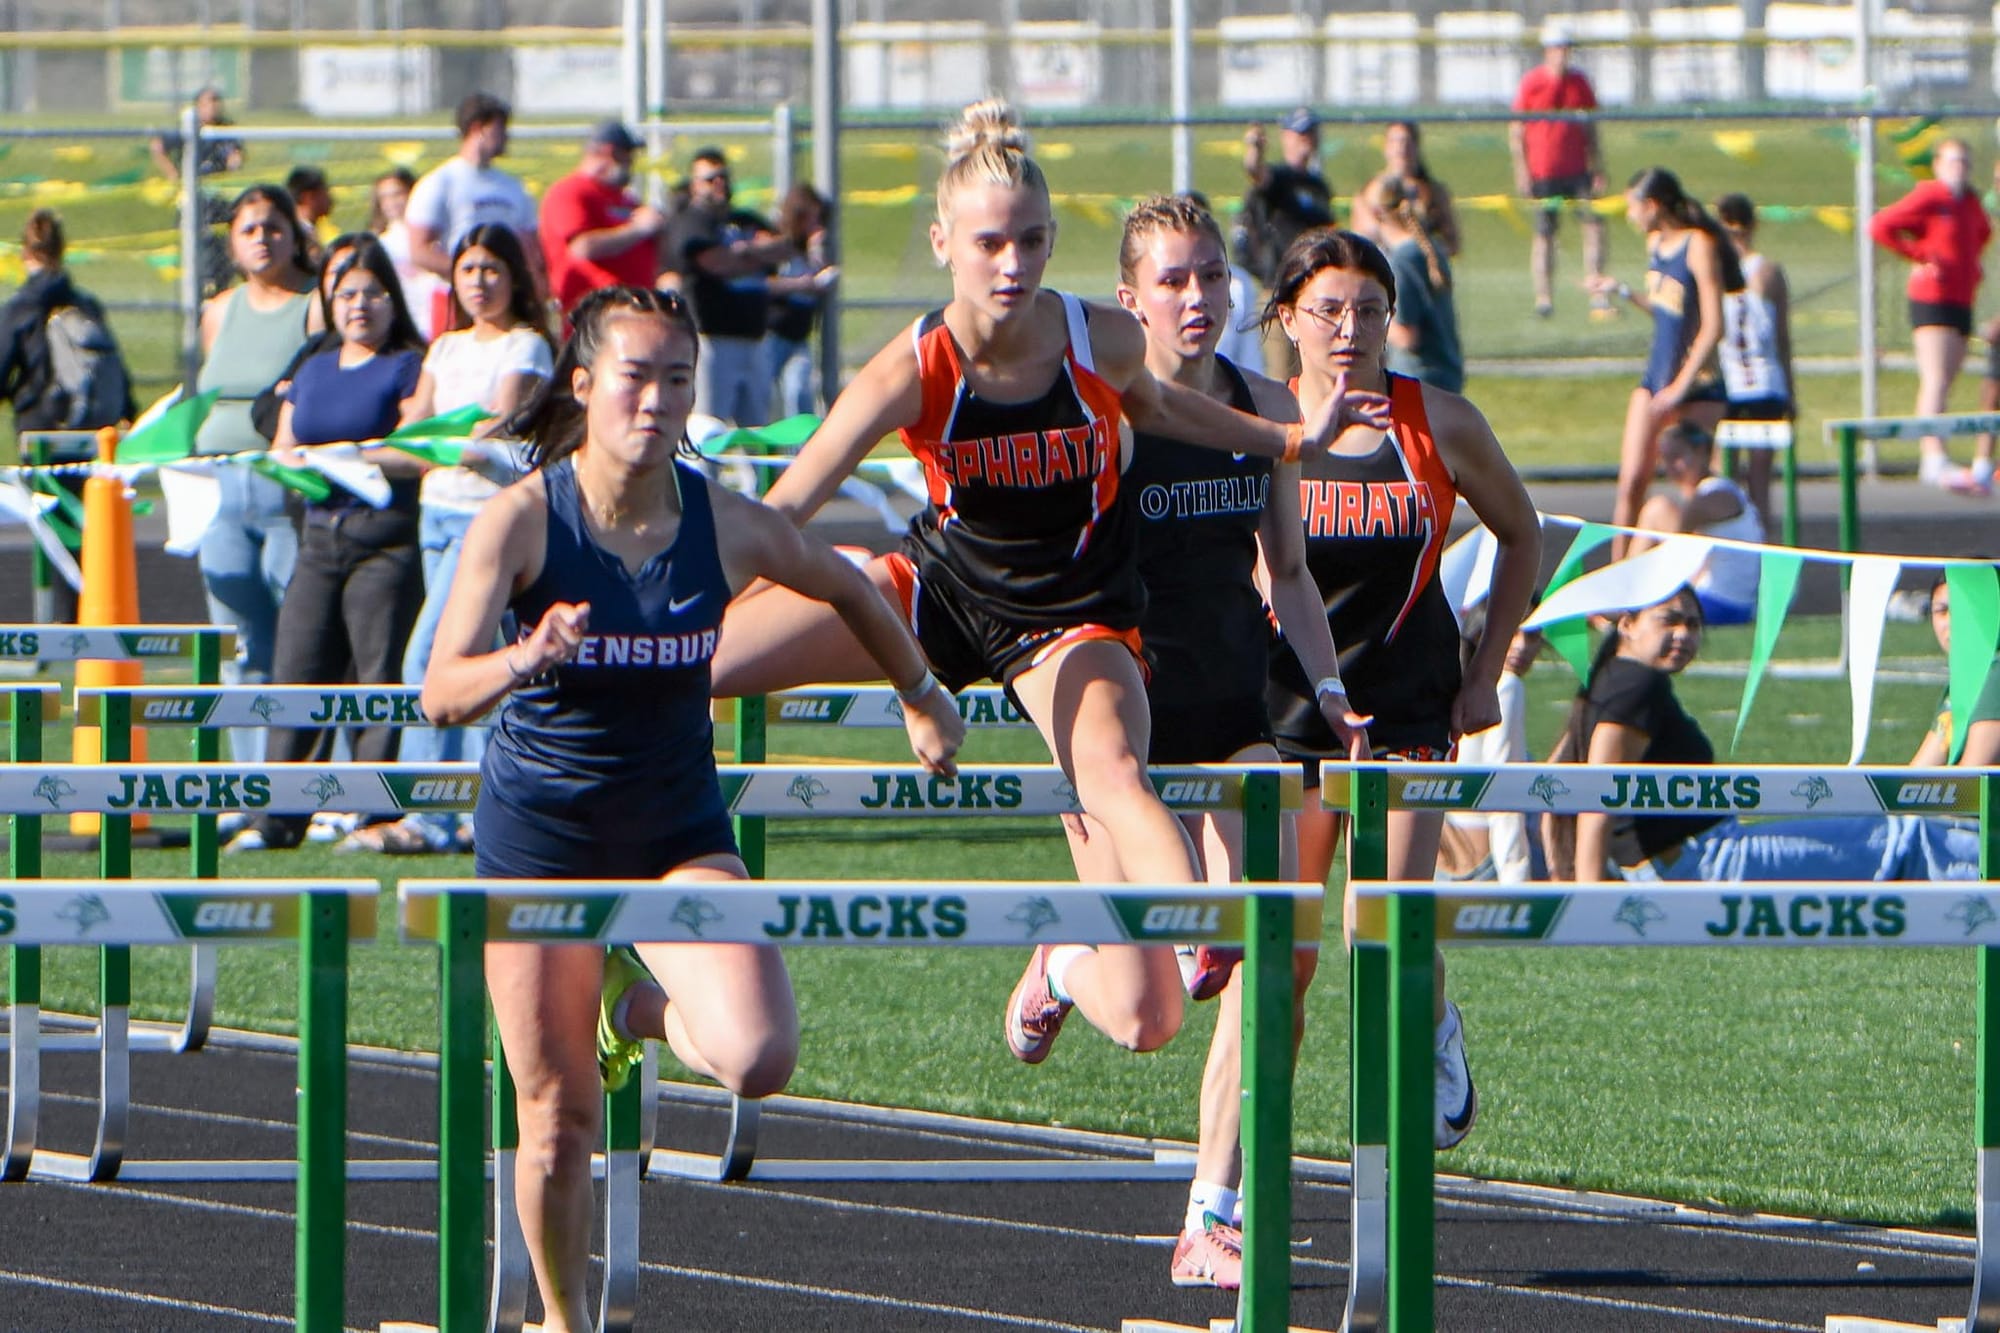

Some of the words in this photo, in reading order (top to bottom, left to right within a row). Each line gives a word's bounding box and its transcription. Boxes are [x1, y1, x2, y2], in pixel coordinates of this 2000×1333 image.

[925, 415, 1109, 487] EPHRATA
[1300, 480, 1438, 537] HRATA
[136, 636, 180, 654] GILL
[144, 700, 195, 719] GILL
[310, 693, 428, 722] JACK
[780, 699, 831, 718] GILL
[107, 774, 271, 808] JACKS
[409, 780, 475, 801] GILL
[860, 774, 1023, 809] JACKS
[1160, 781, 1222, 802] GILL
[1401, 781, 1464, 802] GILL
[1601, 774, 1761, 809] JACKS
[1896, 783, 1957, 804] GILL
[194, 903, 273, 929] GILL
[507, 903, 588, 930] GILL
[763, 895, 968, 938] JACKS
[1142, 904, 1222, 933] GILL
[1453, 903, 1532, 932] GILL
[1705, 895, 1908, 938] JACKS
